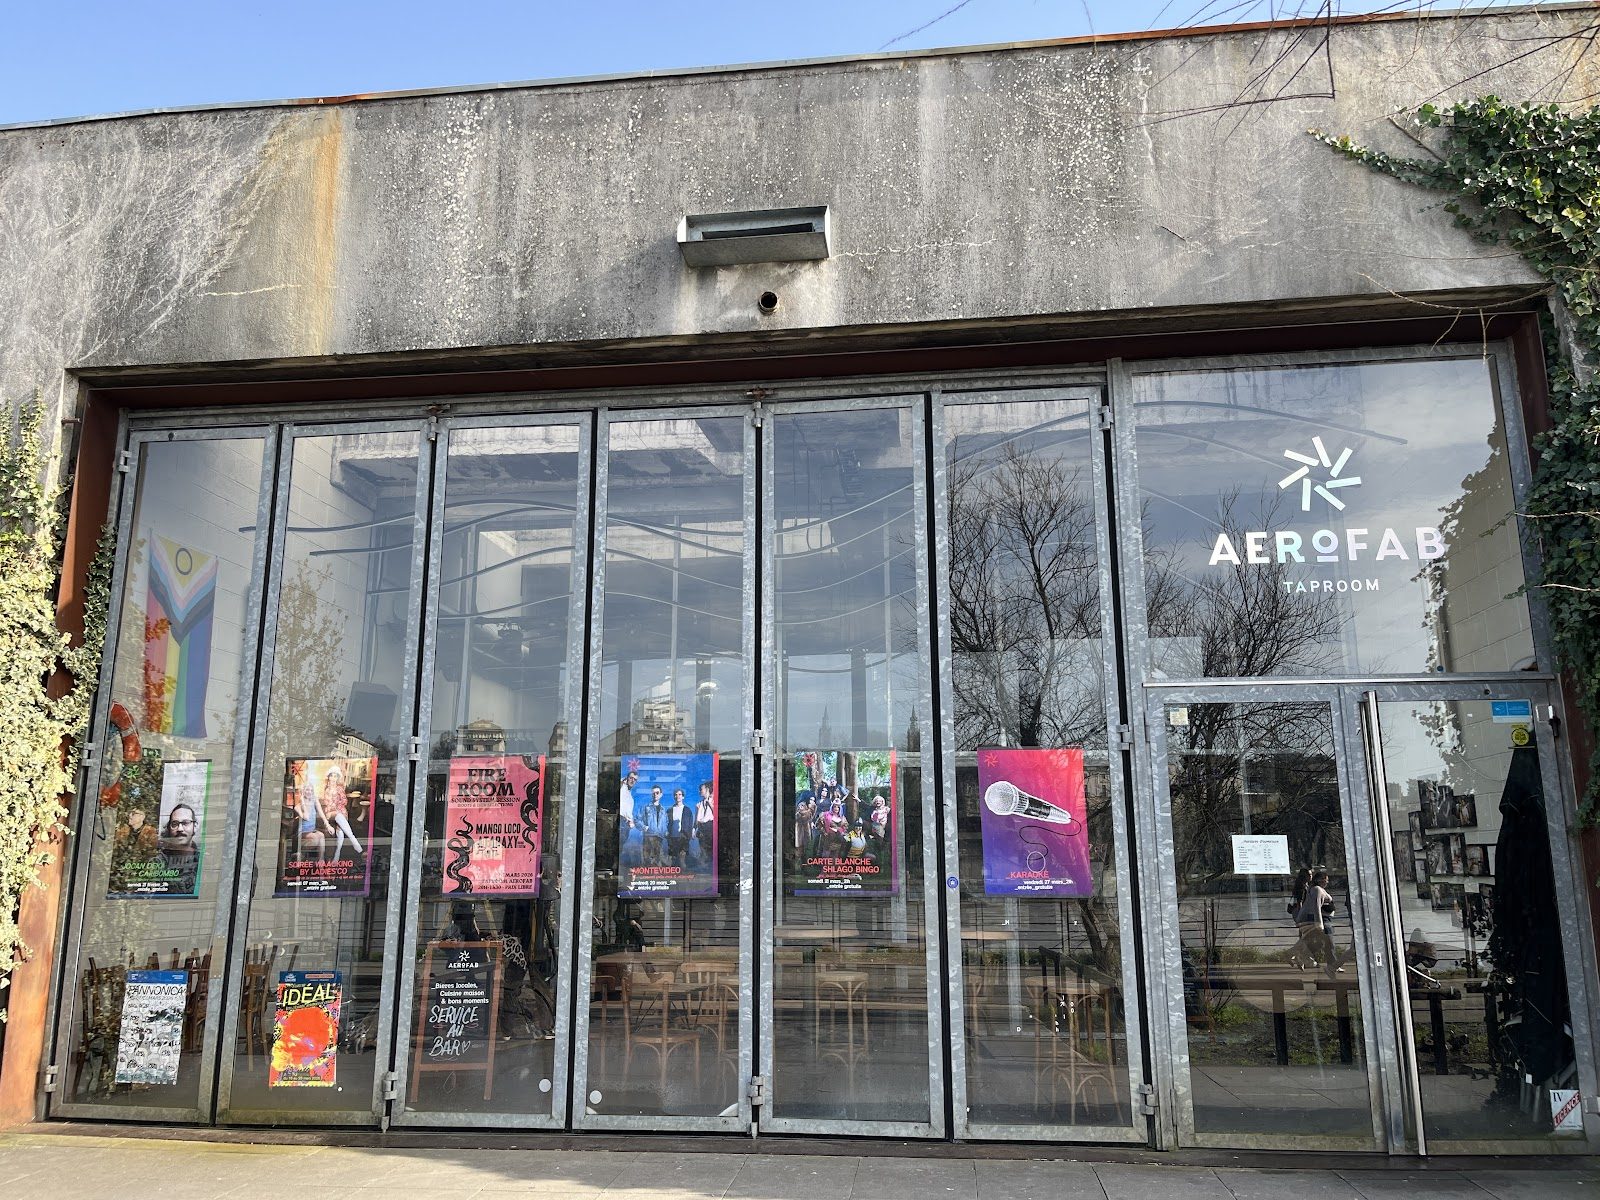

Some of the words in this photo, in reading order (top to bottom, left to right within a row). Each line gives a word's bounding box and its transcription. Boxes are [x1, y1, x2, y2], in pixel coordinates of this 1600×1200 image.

[1208, 527, 1447, 565] AEROFAB
[1283, 578, 1380, 594] TAPROOM
[467, 768, 507, 782] FIRE
[457, 782, 515, 797] ROOM
[475, 823, 502, 835] MANGO
[504, 823, 521, 834] LOCO
[834, 857, 872, 865] BLANCHE
[299, 867, 309, 876] BY
[822, 865, 854, 874] SHLAGO
[855, 865, 880, 874] BINGO
[281, 982, 336, 1008] IDÉAL
[429, 1005, 479, 1025] SERVICE
[446, 1024, 464, 1038] AU
[429, 1036, 460, 1057] BAR
[1554, 1091, 1581, 1128] LICENCE
